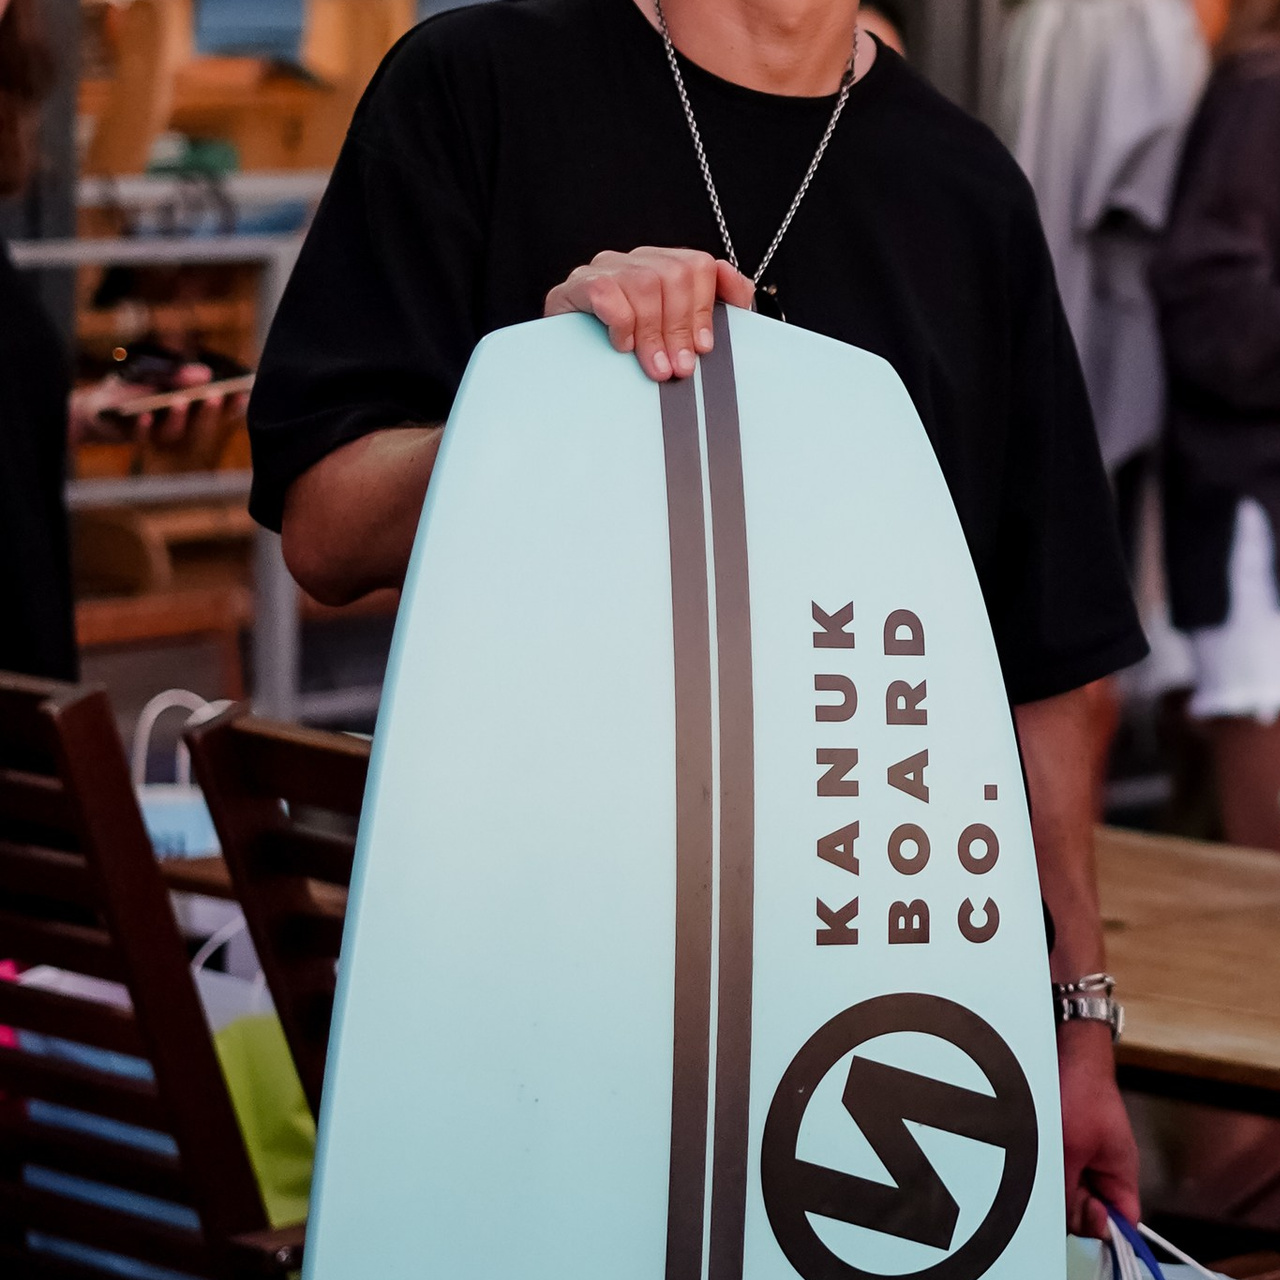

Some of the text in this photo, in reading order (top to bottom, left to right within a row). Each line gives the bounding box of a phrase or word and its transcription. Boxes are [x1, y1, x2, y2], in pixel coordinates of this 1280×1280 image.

[812, 599, 859, 947] KANUK
[883, 608, 930, 945] BOARD
[957, 783, 1000, 945] CO.
